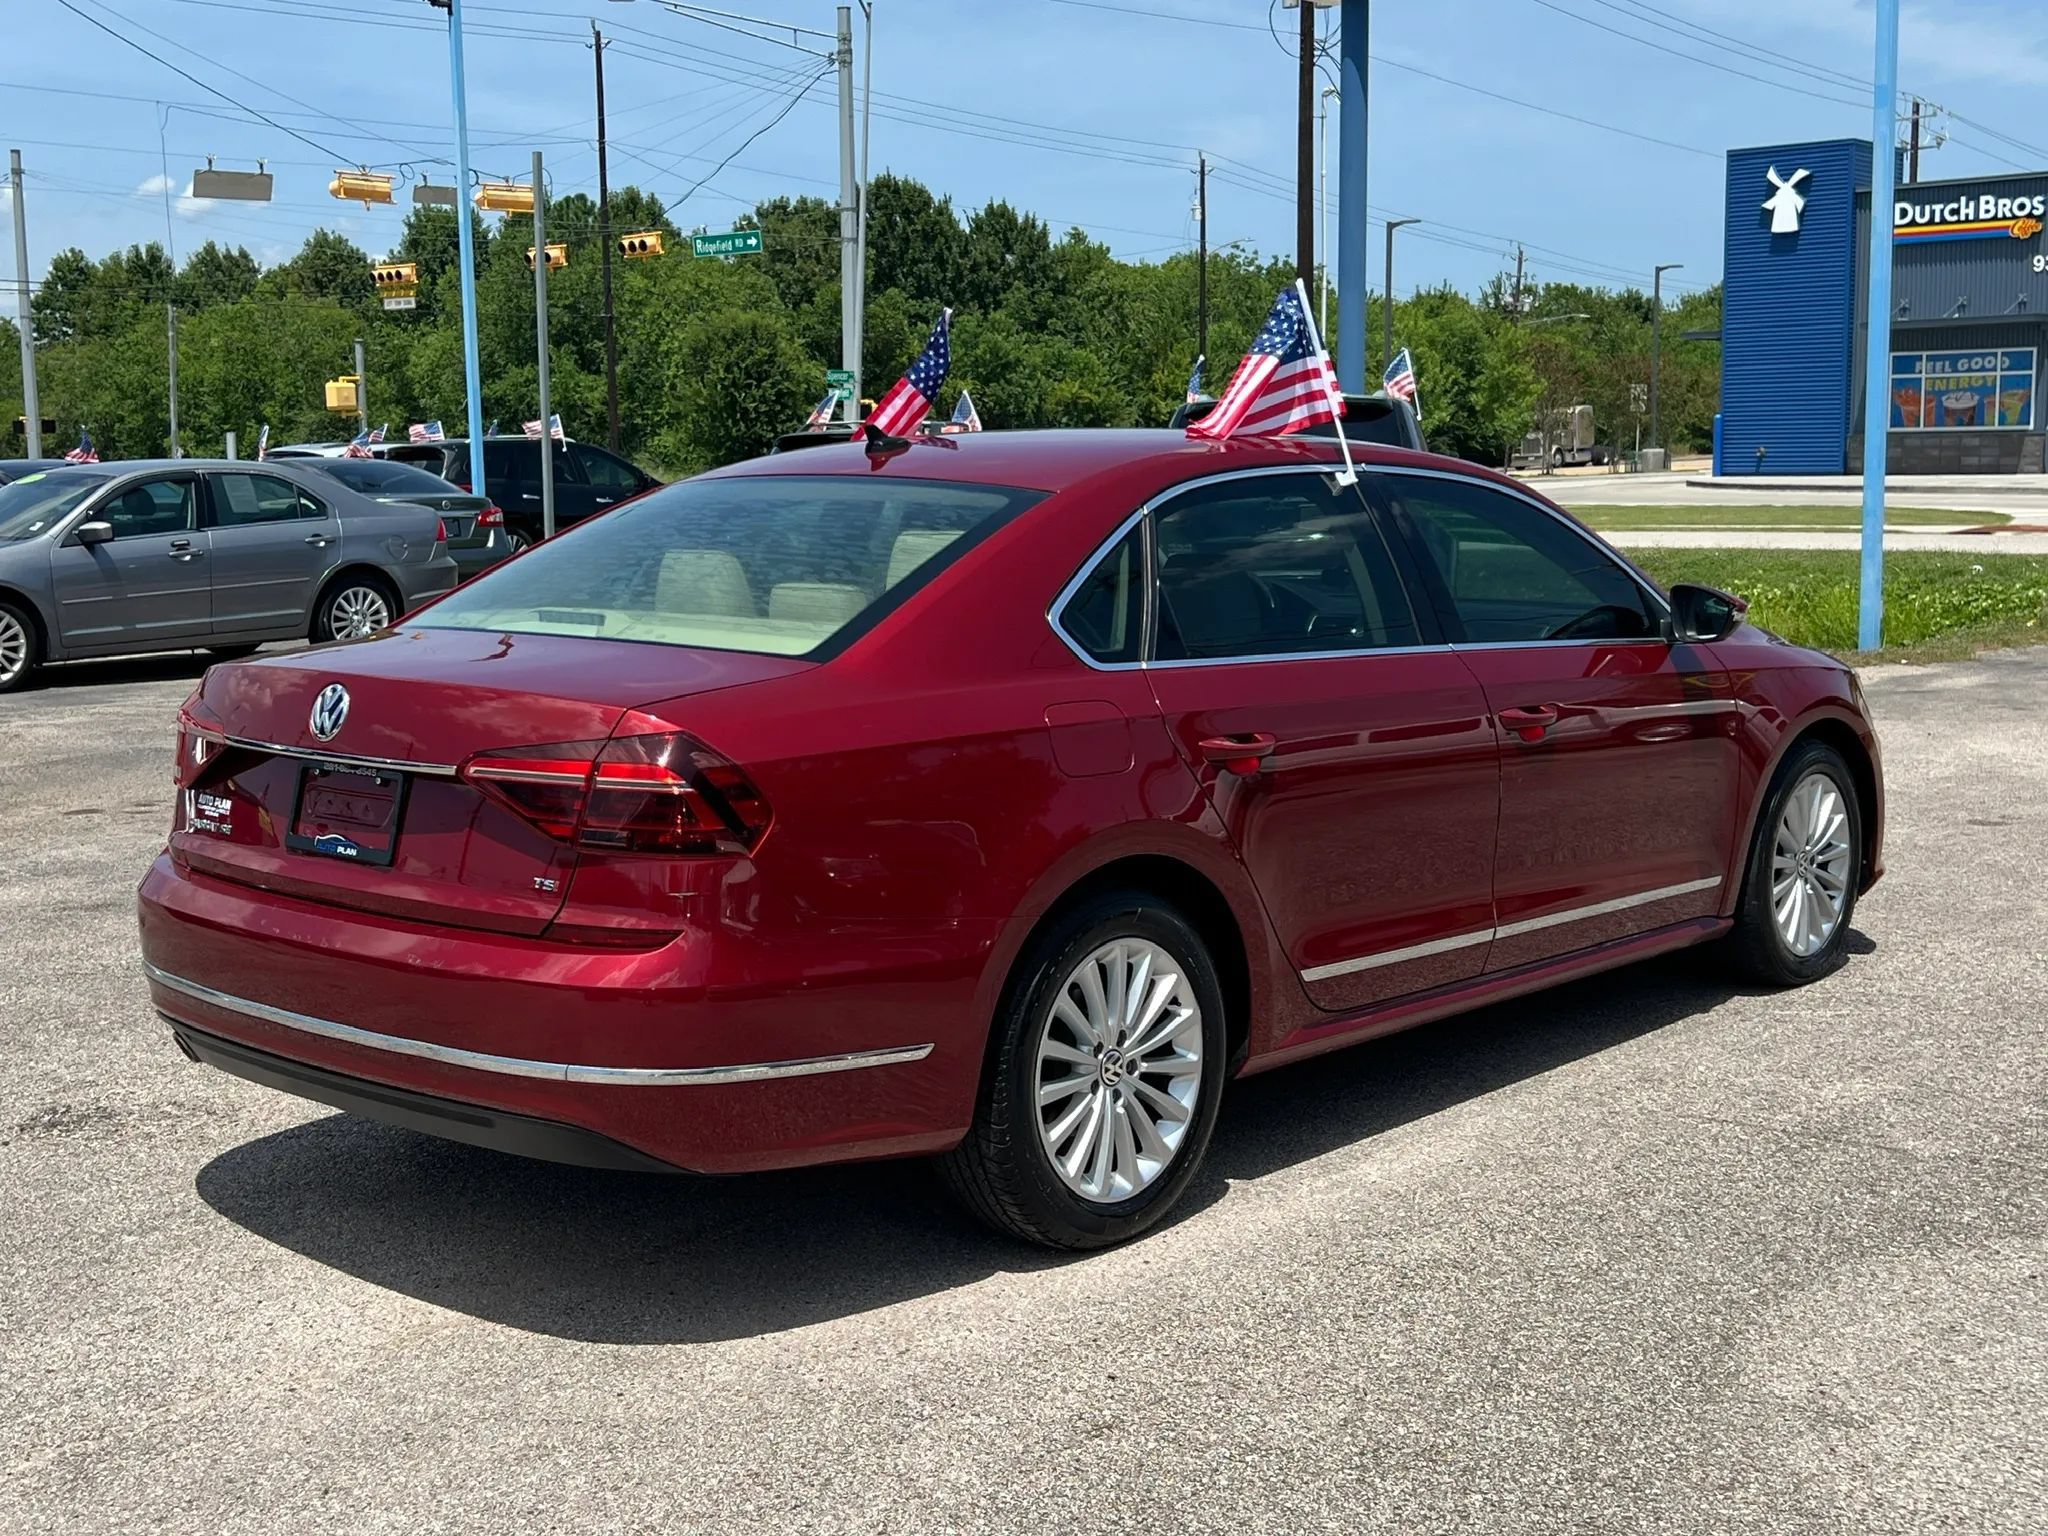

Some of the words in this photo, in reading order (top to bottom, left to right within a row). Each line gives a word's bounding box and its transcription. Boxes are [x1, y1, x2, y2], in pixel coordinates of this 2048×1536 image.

[1894, 196, 1975, 226] DUTCH
[1979, 195, 2045, 220] BROS
[2010, 217, 2043, 239] Coffee
[695, 239, 733, 256] Ridgefield
[1914, 360, 1953, 374] FEEL
[1956, 355, 2011, 372] GOOD
[1926, 374, 1998, 392] ENERGY
[214, 797, 232, 810] PLAN
[337, 845, 357, 856] PLAN
